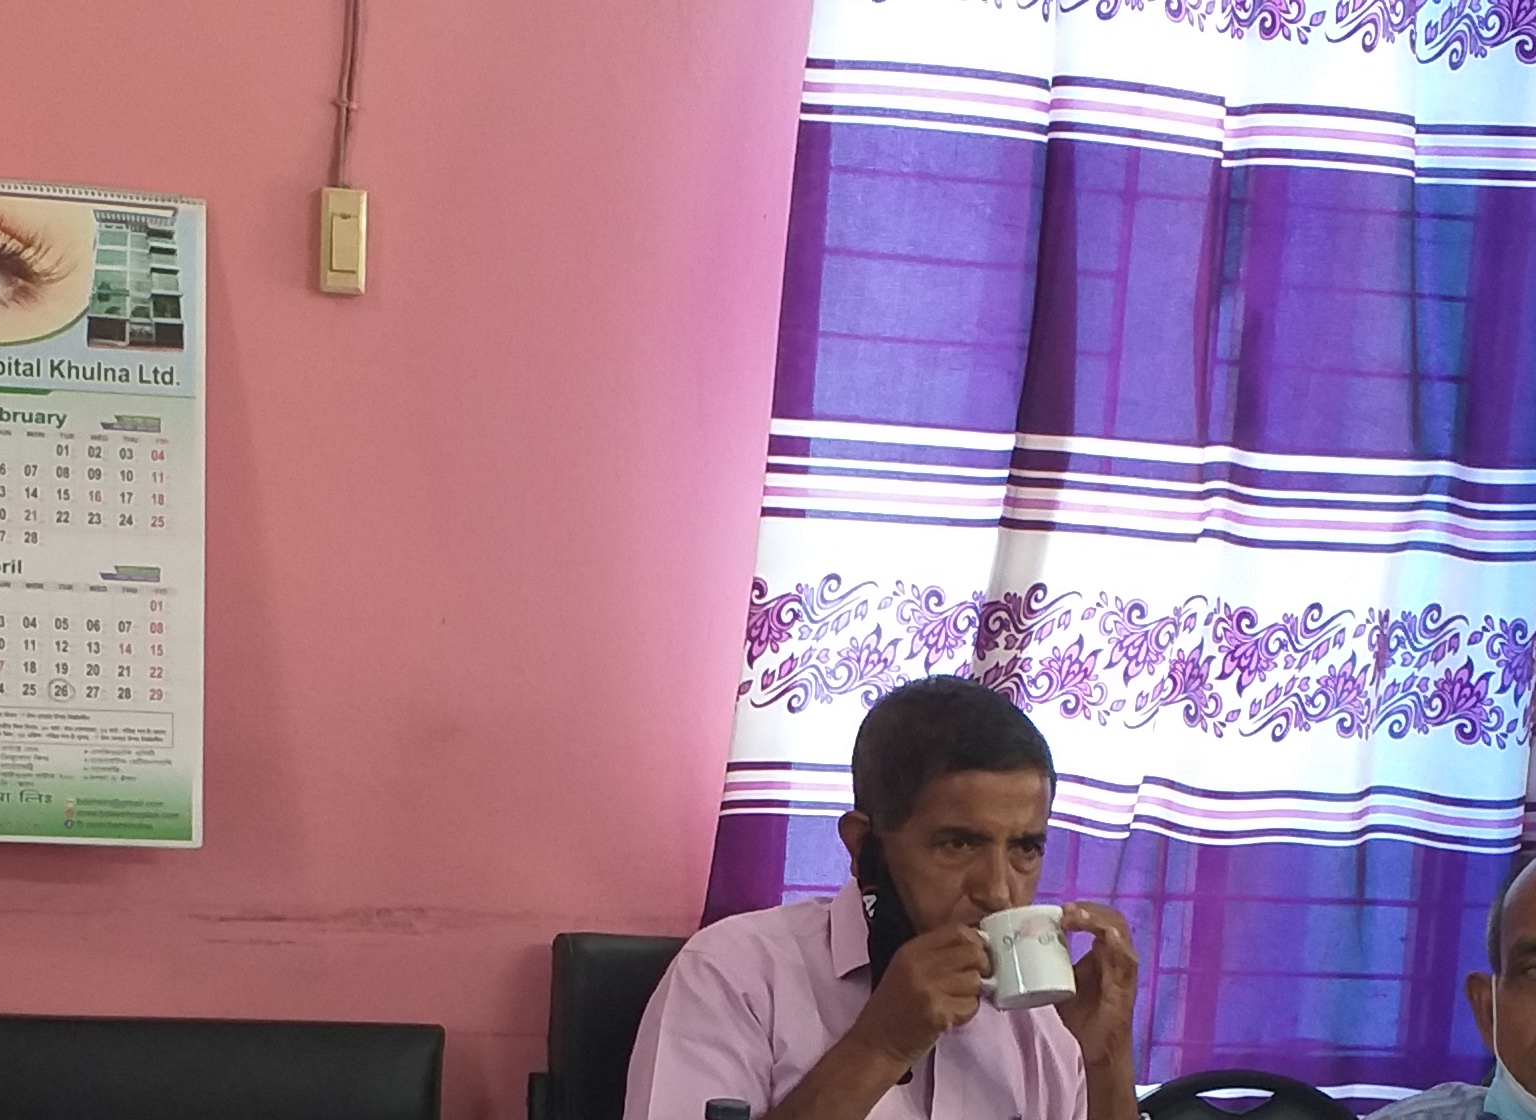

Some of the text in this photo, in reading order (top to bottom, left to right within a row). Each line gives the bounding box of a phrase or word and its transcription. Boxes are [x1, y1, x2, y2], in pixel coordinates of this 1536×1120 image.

[51, 359, 130, 382] Khulna
[139, 364, 181, 385] Ltd.
[56, 444, 164, 461] 01 02 03 04
[24, 464, 37, 476] 07
[88, 468, 101, 480] 09
[120, 470, 133, 481] 10
[152, 471, 163, 483] 11
[25, 487, 38, 499] 14
[57, 488, 70, 500] 15
[89, 490, 101, 502] 16
[120, 492, 133, 504] 17
[24, 509, 37, 521] 21
[56, 511, 69, 523] 22
[88, 512, 101, 524] 23
[119, 514, 133, 526] 24
[151, 516, 164, 527] 25
[24, 531, 38, 544] 28
[150, 600, 162, 611] 01
[23, 616, 37, 628] 04
[86, 619, 100, 632] 06
[118, 621, 132, 633] 07
[24, 639, 35, 651] 11
[56, 640, 68, 652] 12
[87, 642, 100, 654] 13
[119, 643, 132, 654] 14
[151, 644, 163, 656] 15
[23, 661, 36, 673] 18
[55, 663, 68, 674] 19
[86, 664, 100, 676] 20
[118, 665, 130, 677] 21
[150, 667, 163, 678] 22
[23, 684, 36, 696] 25
[86, 686, 100, 698] 27
[117, 687, 131, 699] 28
[150, 688, 163, 700] 29
